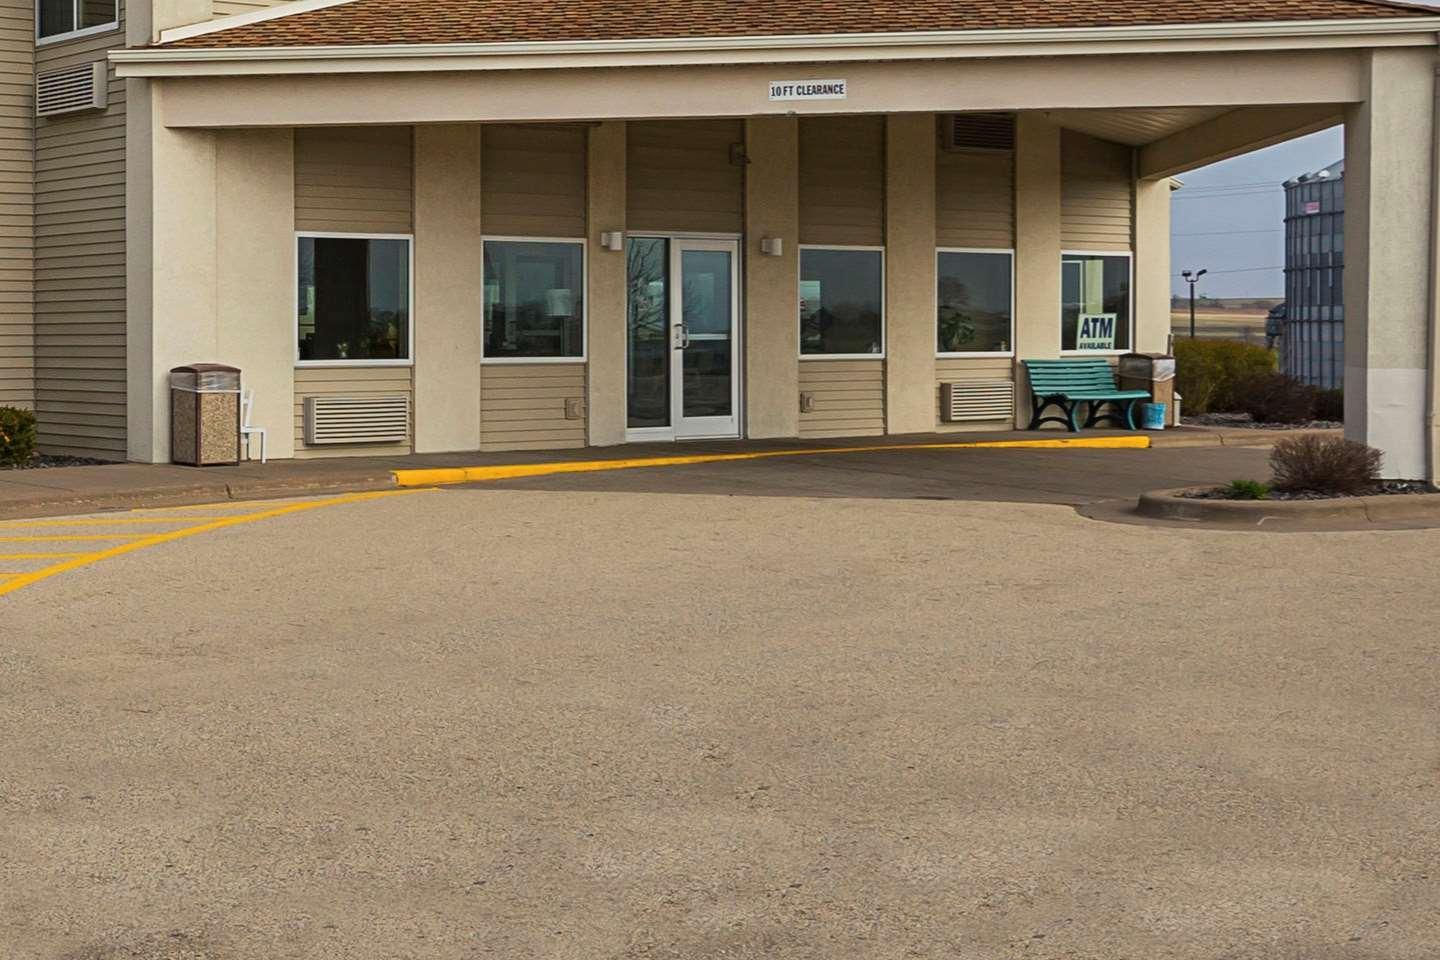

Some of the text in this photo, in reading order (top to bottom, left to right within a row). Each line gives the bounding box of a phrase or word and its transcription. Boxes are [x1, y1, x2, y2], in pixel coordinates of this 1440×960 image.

[771, 84, 844, 96] 10 FT CLEARANCE
[1080, 318, 1113, 338] ATM
[1079, 342, 1112, 350] AVAILABLE
